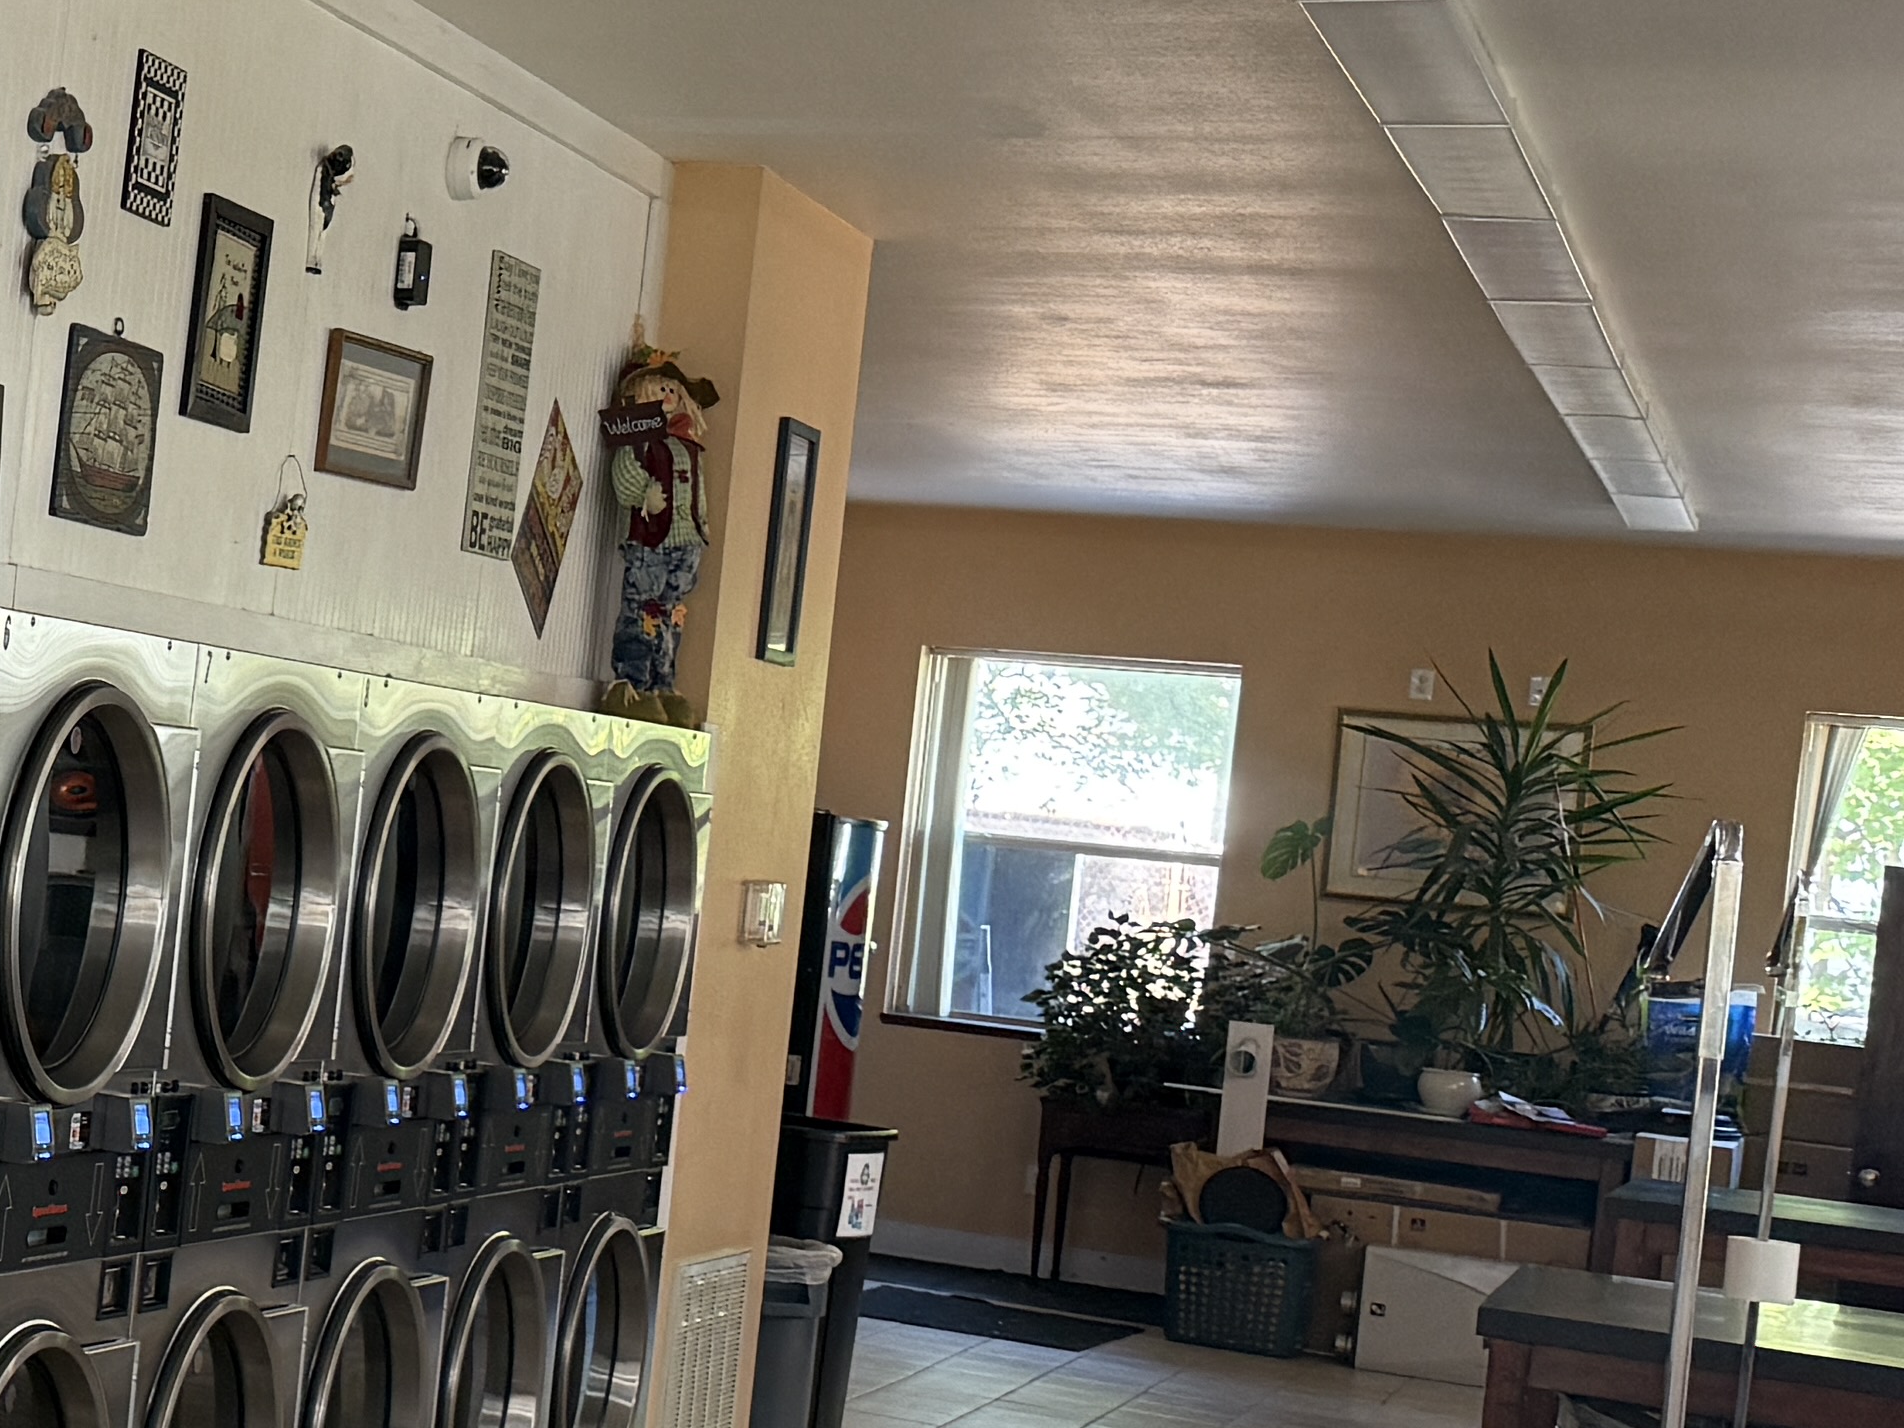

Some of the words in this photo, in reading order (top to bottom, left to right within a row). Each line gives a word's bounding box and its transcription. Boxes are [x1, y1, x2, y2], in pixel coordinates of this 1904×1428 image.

[604, 416, 663, 437] Welcome
[469, 510, 489, 552] BE
[3, 614, 11, 651] 6
